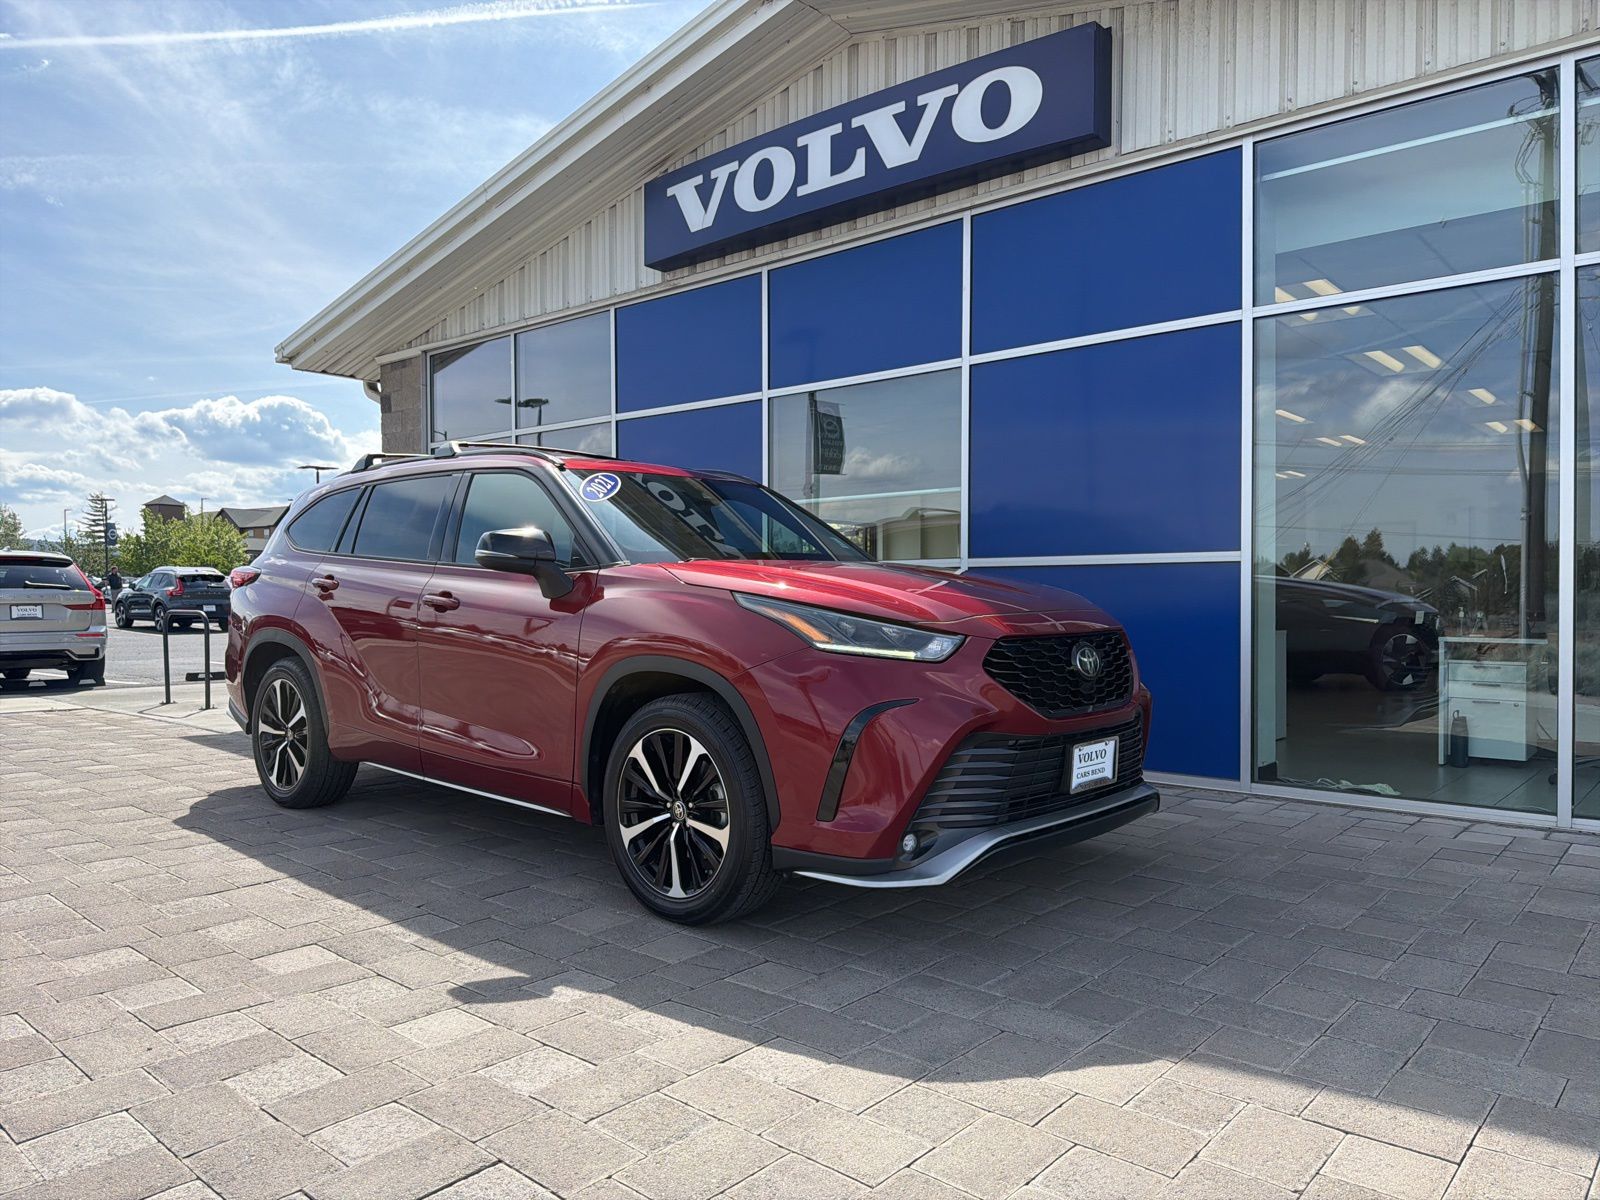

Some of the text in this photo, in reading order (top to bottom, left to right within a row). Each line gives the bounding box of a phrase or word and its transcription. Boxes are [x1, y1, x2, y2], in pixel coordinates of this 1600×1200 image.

[666, 65, 1044, 234] VOLVO
[586, 475, 616, 499] 2021
[1078, 748, 1107, 764] VOLVO
[1076, 767, 1105, 779] CARS BEND
